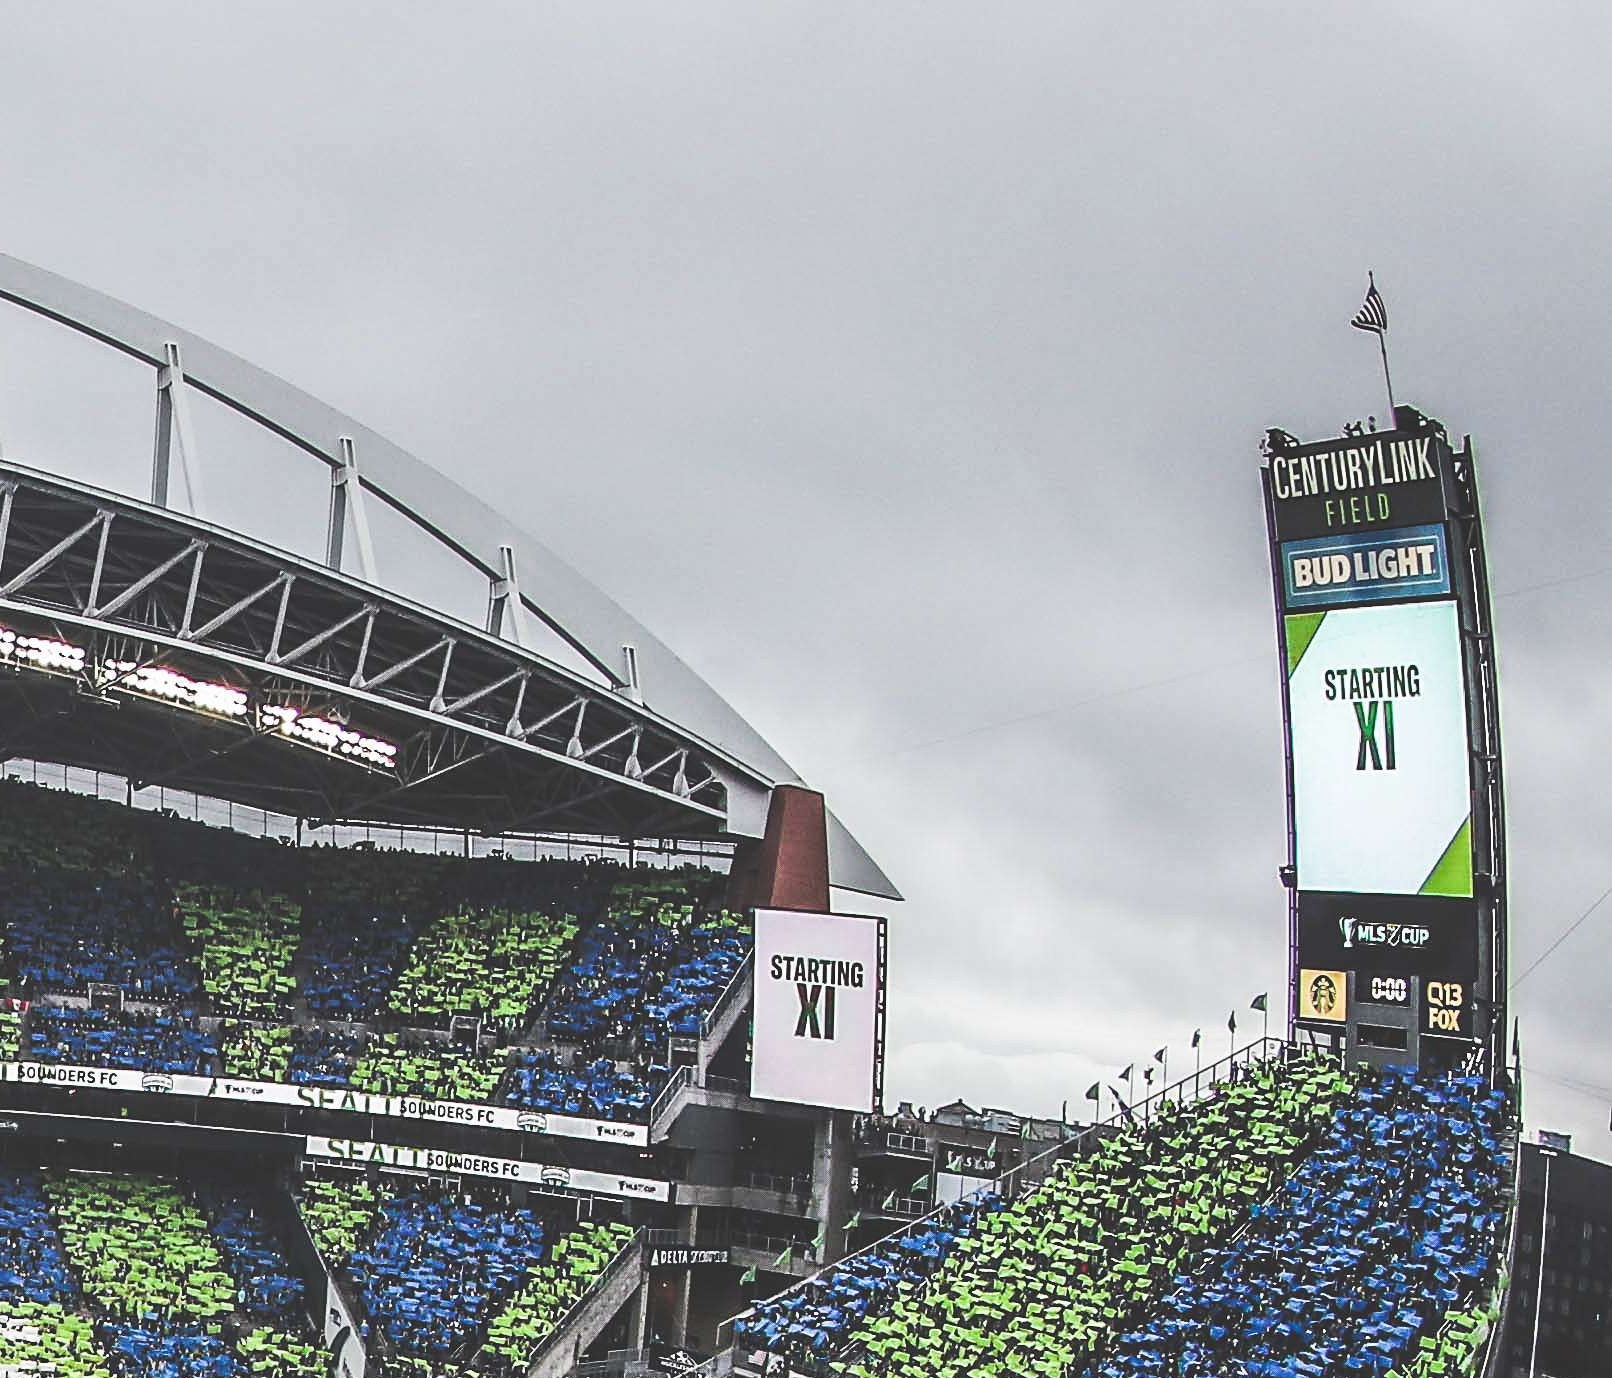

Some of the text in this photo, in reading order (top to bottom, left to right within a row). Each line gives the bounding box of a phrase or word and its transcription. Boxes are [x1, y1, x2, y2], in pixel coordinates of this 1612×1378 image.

[1326, 493, 1390, 527] FIELD
[1293, 545, 1435, 587] BUD LIGHT
[1325, 665, 1420, 701] STARTING
[1353, 700, 1397, 771] XI
[1358, 926, 1429, 944] MLS CUP
[771, 955, 864, 988] STARTING
[1371, 978, 1406, 1001] 0:00
[1428, 982, 1463, 1007] Q13
[794, 983, 836, 1040] XI
[1428, 1008, 1460, 1032] FOX
[100, 1072, 118, 1086] FC
[399, 1098, 495, 1124] SOUNDERS FC
[426, 1152, 520, 1177] SOUNDERS FC
[661, 1251, 688, 1264] DELTA
